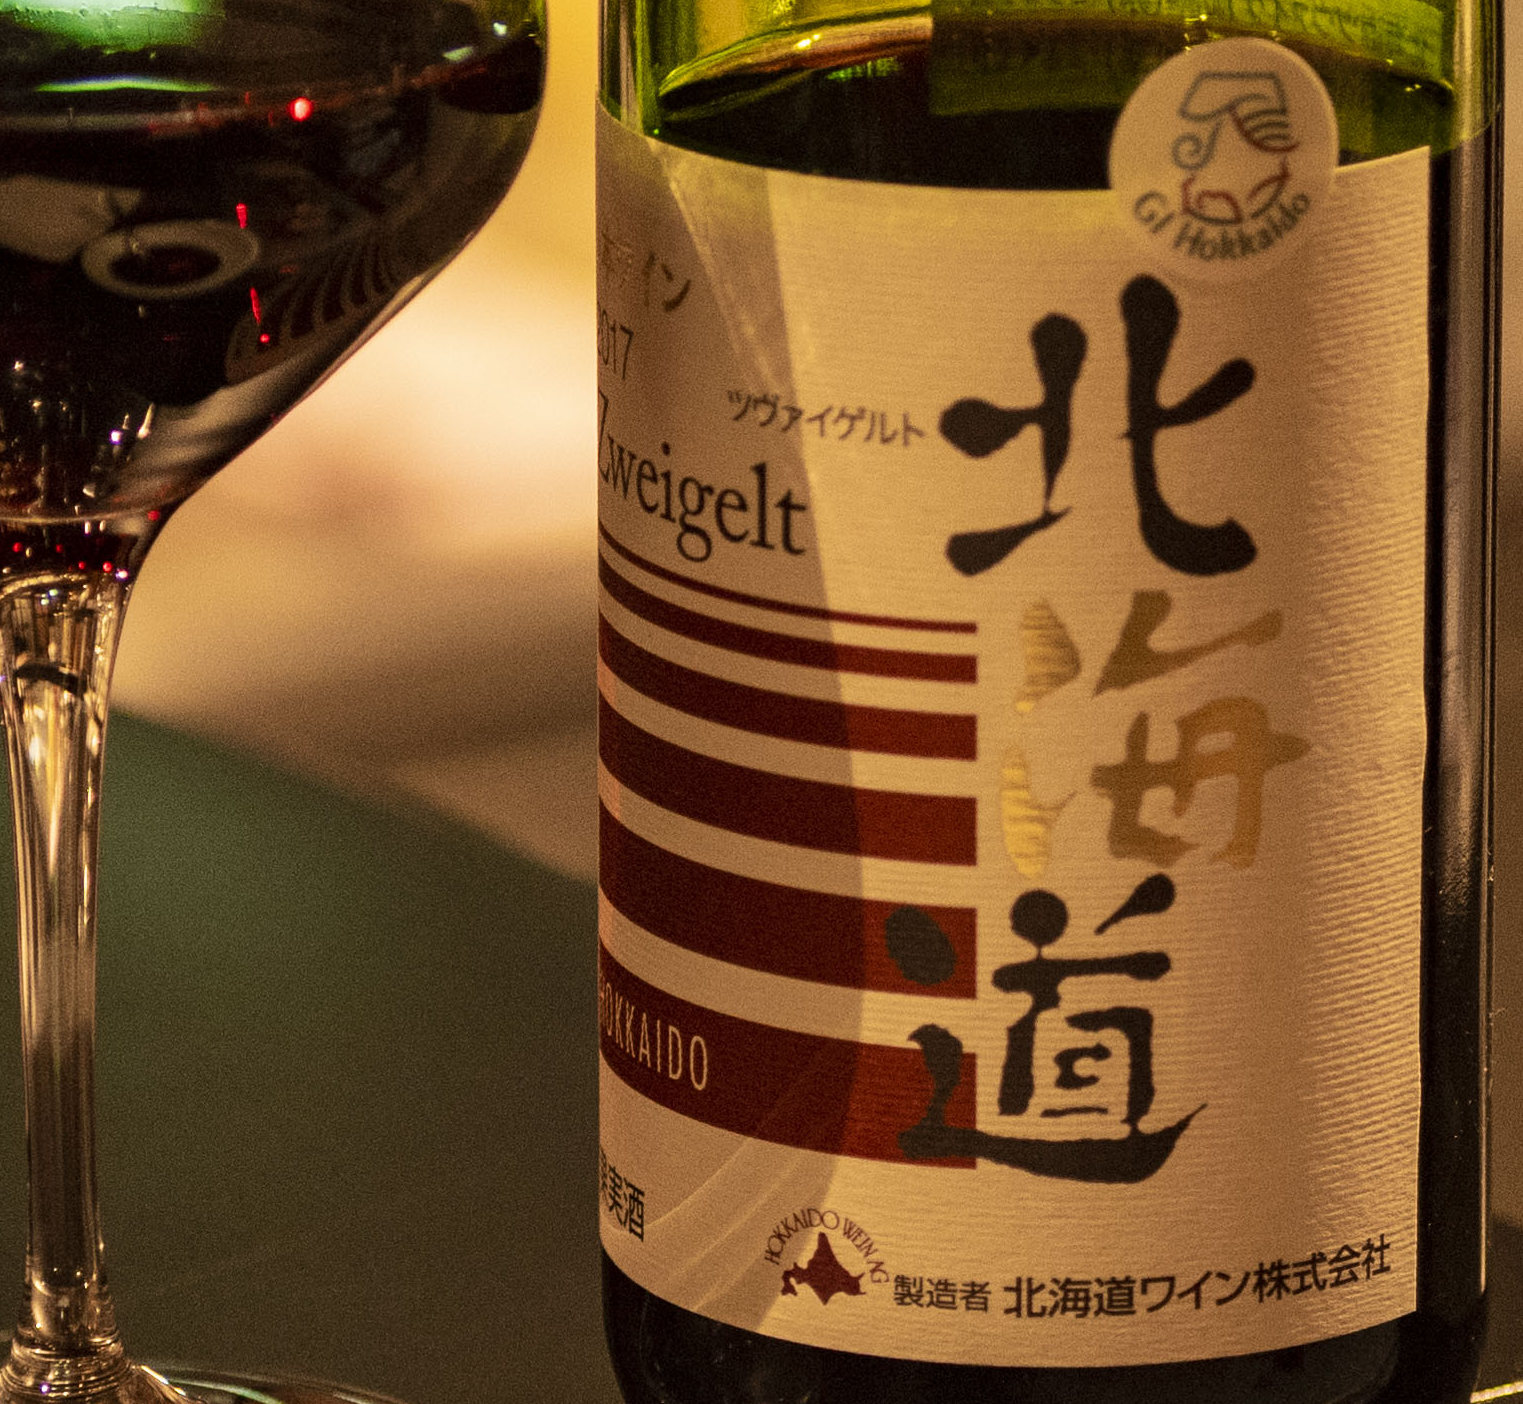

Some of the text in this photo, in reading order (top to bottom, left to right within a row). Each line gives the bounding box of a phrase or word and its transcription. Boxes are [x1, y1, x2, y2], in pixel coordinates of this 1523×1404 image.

[1173, 193, 1312, 263] Hokkaido
[727, 390, 926, 448] ツヴァイゲルト
[597, 386, 807, 563] Zweigelt
[897, 273, 1312, 1185] 北海道
[764, 1207, 840, 1266] HOKKAIDO
[843, 1217, 879, 1258] WEIN
[893, 1233, 1392, 1319] 製造者 北海道ワイン株式会社
